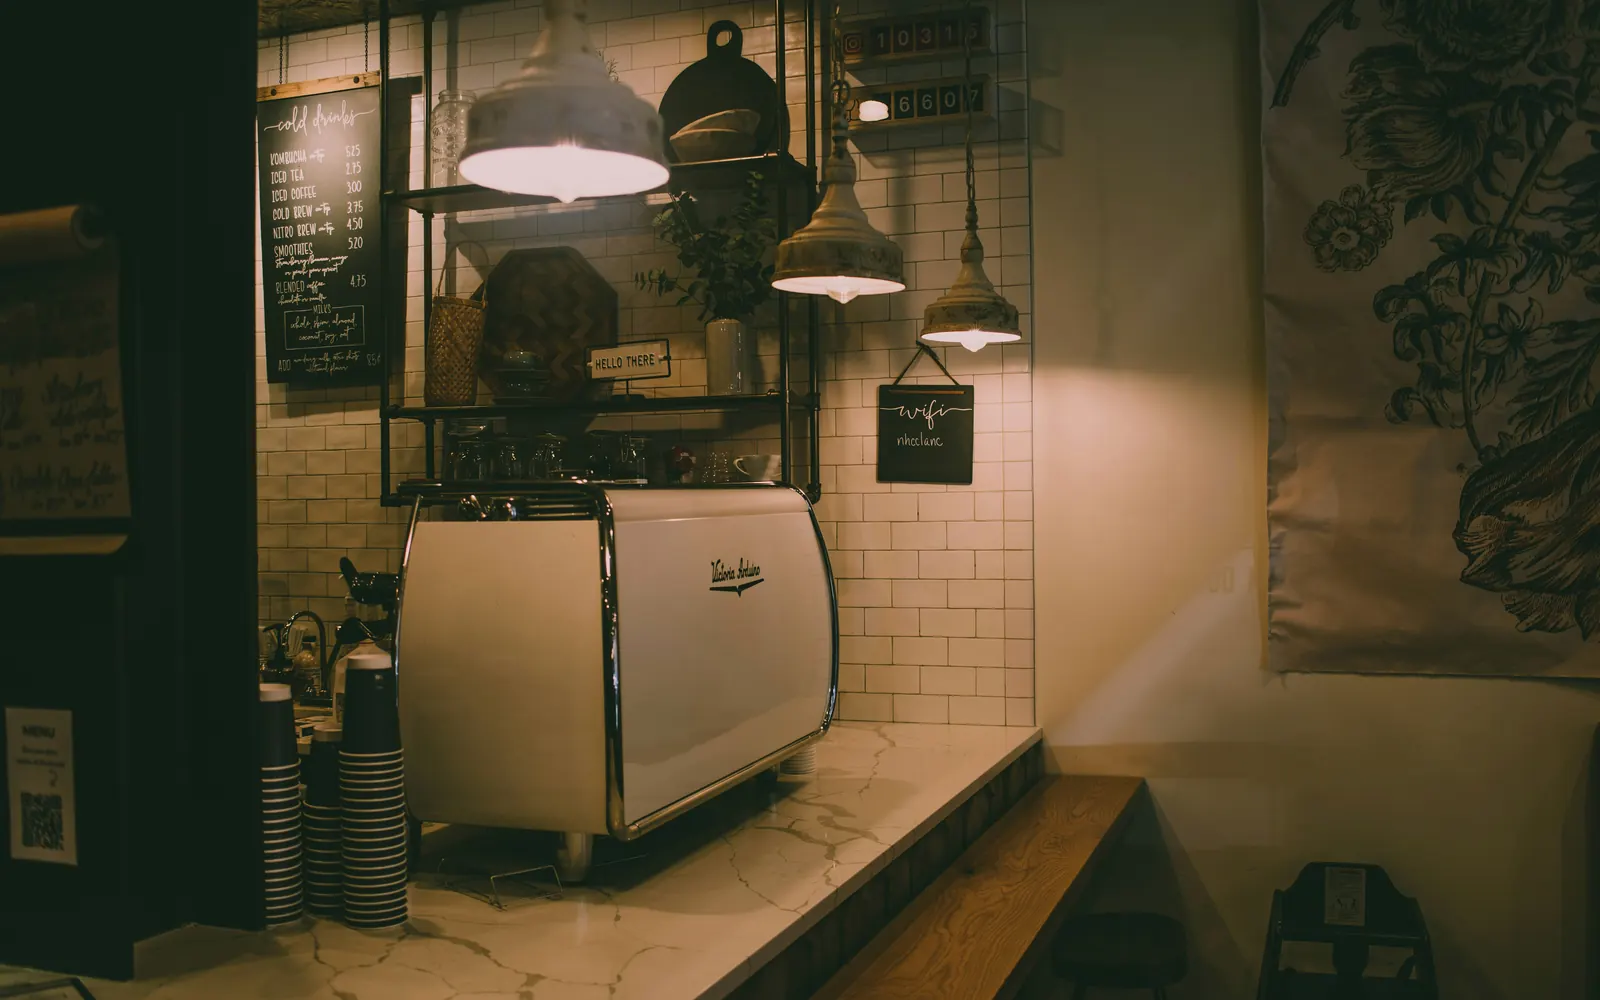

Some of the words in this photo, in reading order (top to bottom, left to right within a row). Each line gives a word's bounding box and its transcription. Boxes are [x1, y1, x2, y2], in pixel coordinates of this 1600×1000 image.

[264, 105, 308, 136] cold
[313, 100, 376, 134] drinks
[270, 150, 307, 166] KOMBUCHA
[271, 171, 288, 185] ICED
[291, 168, 304, 182] TEA
[272, 188, 288, 203] ICED
[291, 185, 317, 200] COFFEE
[272, 207, 290, 221] COLD
[293, 205, 313, 220] BREW
[273, 225, 294, 240] NITRO
[297, 223, 316, 237] BREW
[273, 242, 314, 258] SMOOTHIES
[275, 280, 305, 295] BLENDED
[306, 280, 326, 295] coffee
[350, 274, 367, 288] 4.75
[313, 303, 332, 315] MILKS
[278, 358, 292, 372] ADD
[595, 356, 623, 370] HELLO
[626, 353, 655, 368] THERE
[880, 399, 973, 430] wifi
[711, 558, 736, 583] Victoria
[736, 557, 761, 580] Arduino
